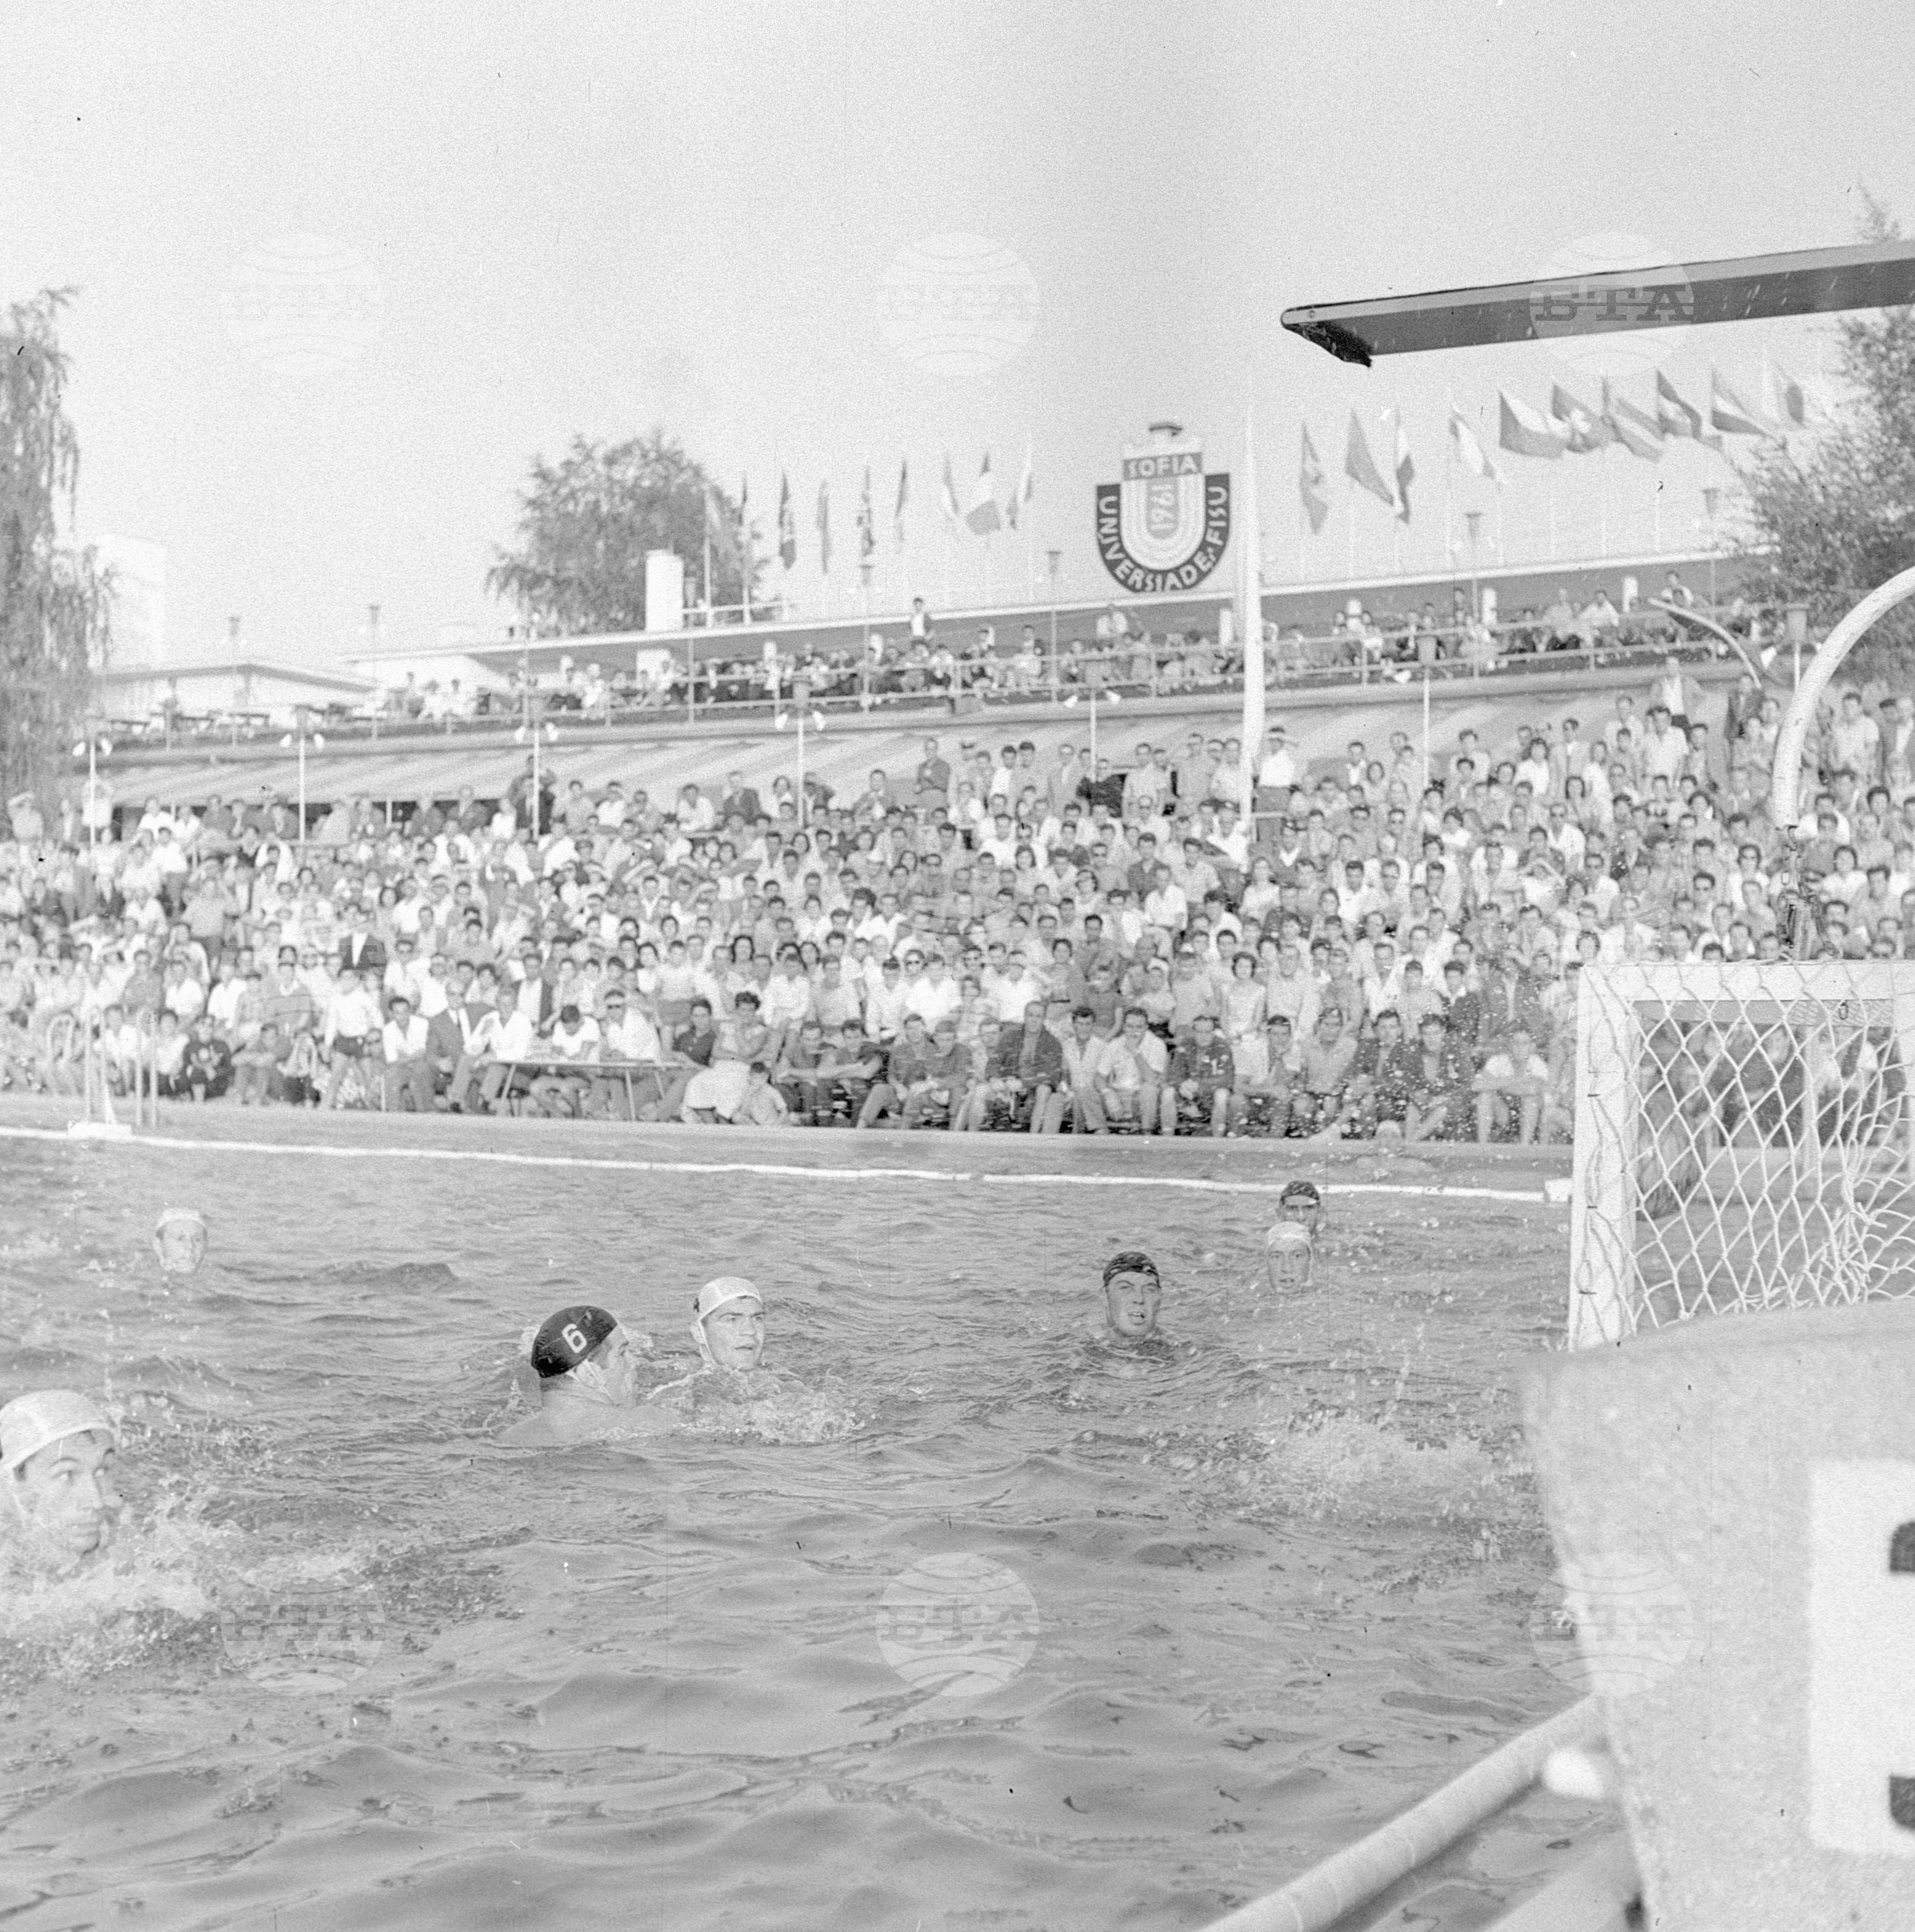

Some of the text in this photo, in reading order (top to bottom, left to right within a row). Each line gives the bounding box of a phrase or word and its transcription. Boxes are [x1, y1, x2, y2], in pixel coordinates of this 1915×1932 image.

[1128, 454, 1198, 478] SOFIA
[1099, 486, 1228, 592] UNIVERSIADE FISU
[562, 1323, 587, 1354] 6
